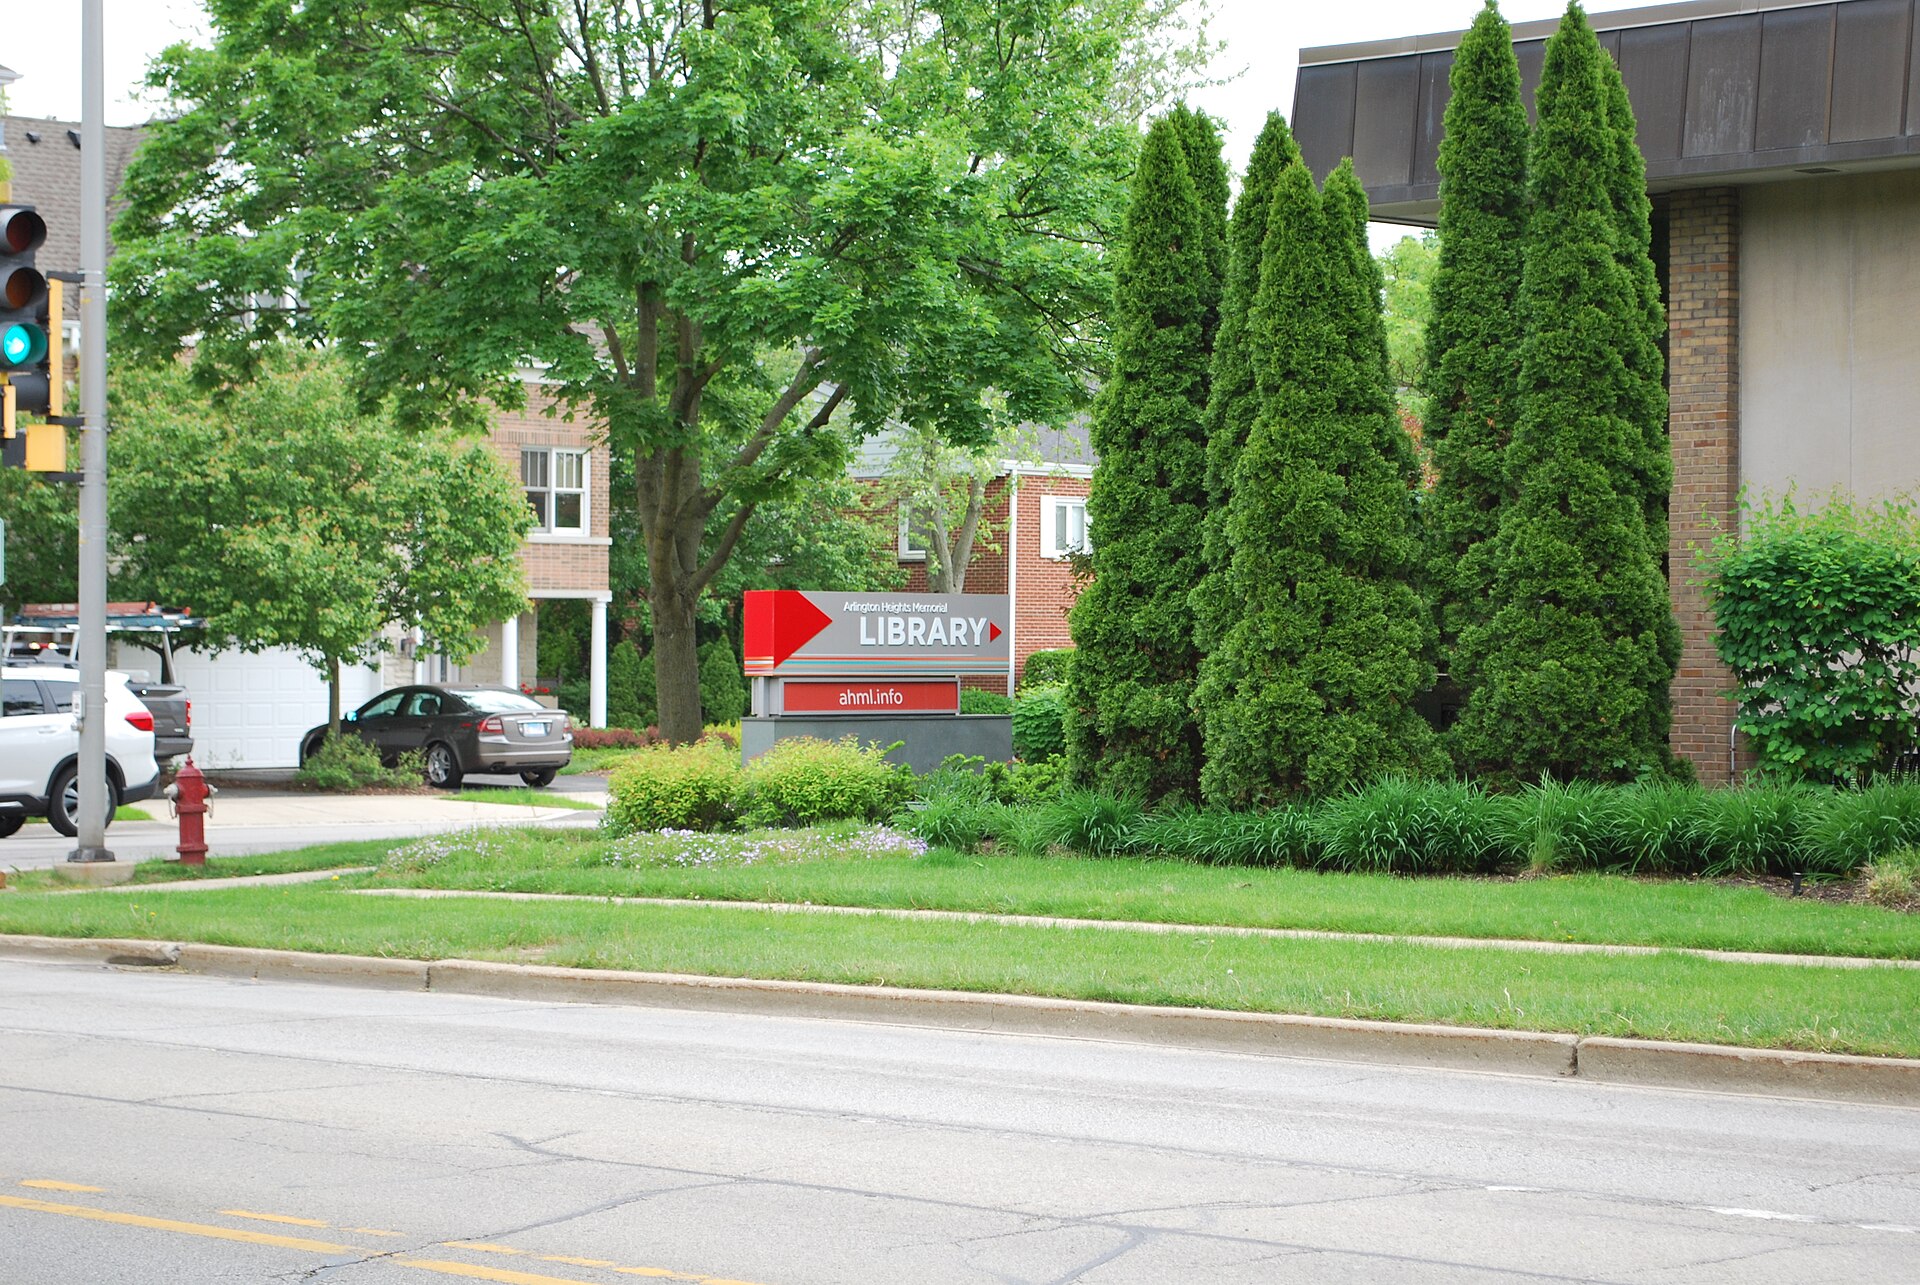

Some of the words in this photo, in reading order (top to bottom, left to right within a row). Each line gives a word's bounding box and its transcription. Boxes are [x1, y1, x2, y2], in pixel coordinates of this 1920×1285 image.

[843, 601, 880, 614] Arlington
[881, 602, 911, 614] Heights
[912, 602, 948, 613] Memorial
[860, 616, 987, 646] LIBRARY
[839, 688, 903, 705] ahml.info
